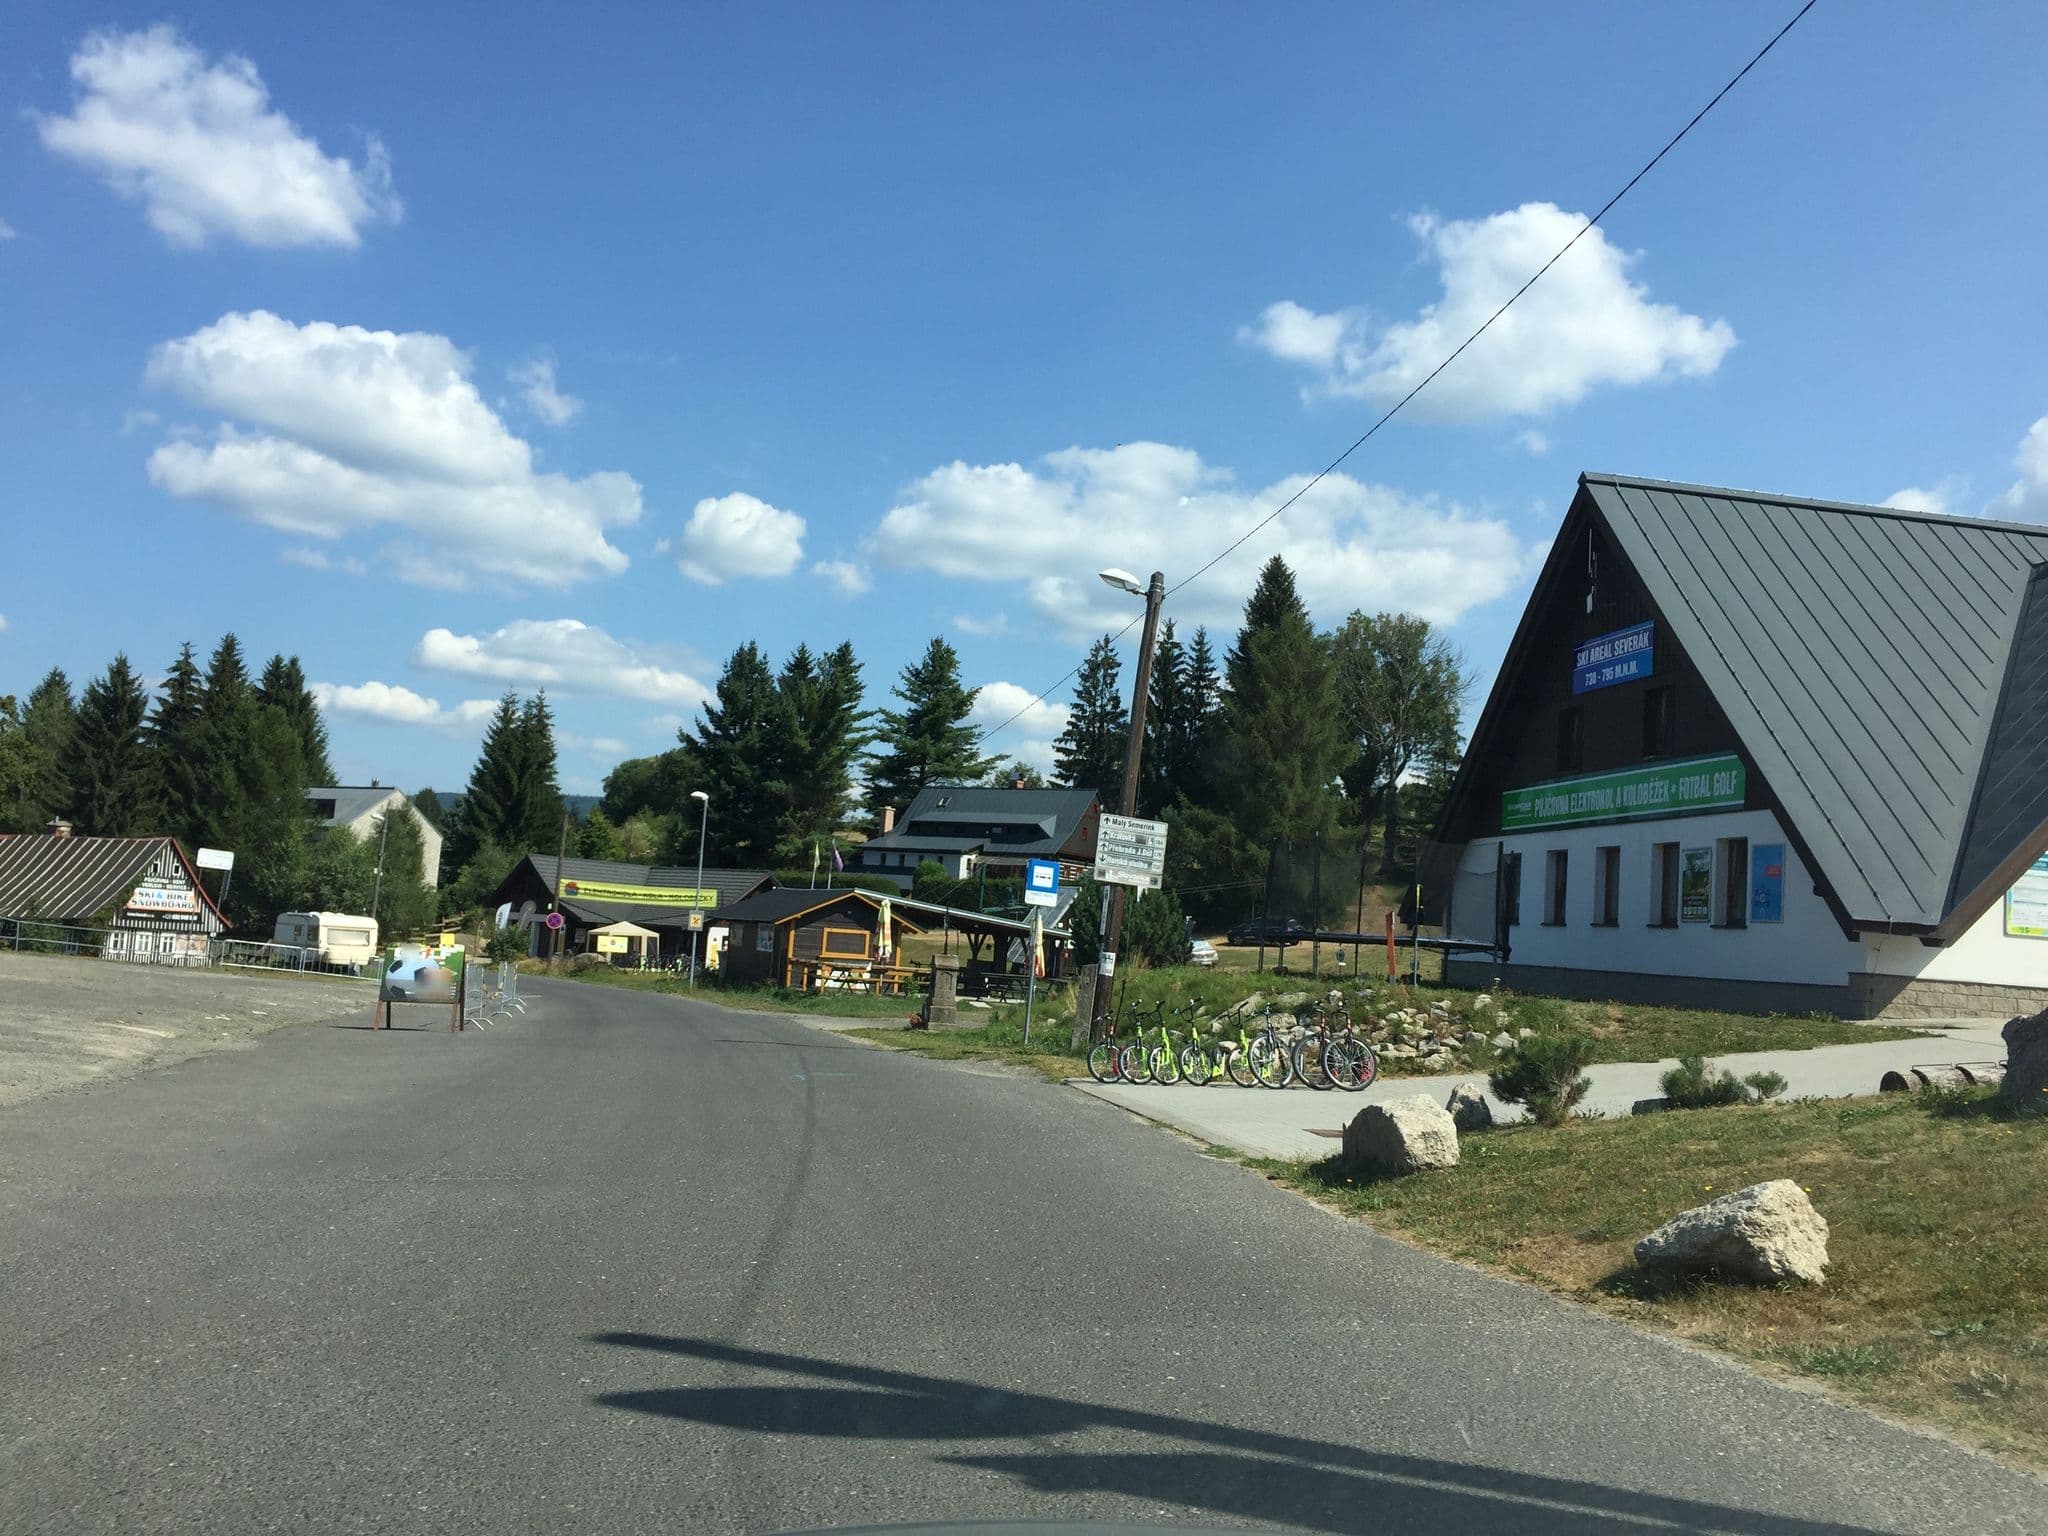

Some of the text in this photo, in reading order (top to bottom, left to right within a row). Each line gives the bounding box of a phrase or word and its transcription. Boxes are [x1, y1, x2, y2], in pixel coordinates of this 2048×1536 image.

[1576, 630, 1649, 668] SKI AREÁL SEVERÁK
[1570, 788, 1614, 813] ELEKTROKOL
[1615, 786, 1621, 808] A
[1622, 776, 1669, 807] KOLOBĚŽEK
[1679, 774, 1710, 801] FOTBAL
[1713, 769, 1737, 796] GOLF
[131, 899, 194, 909] SNOWBOARD
